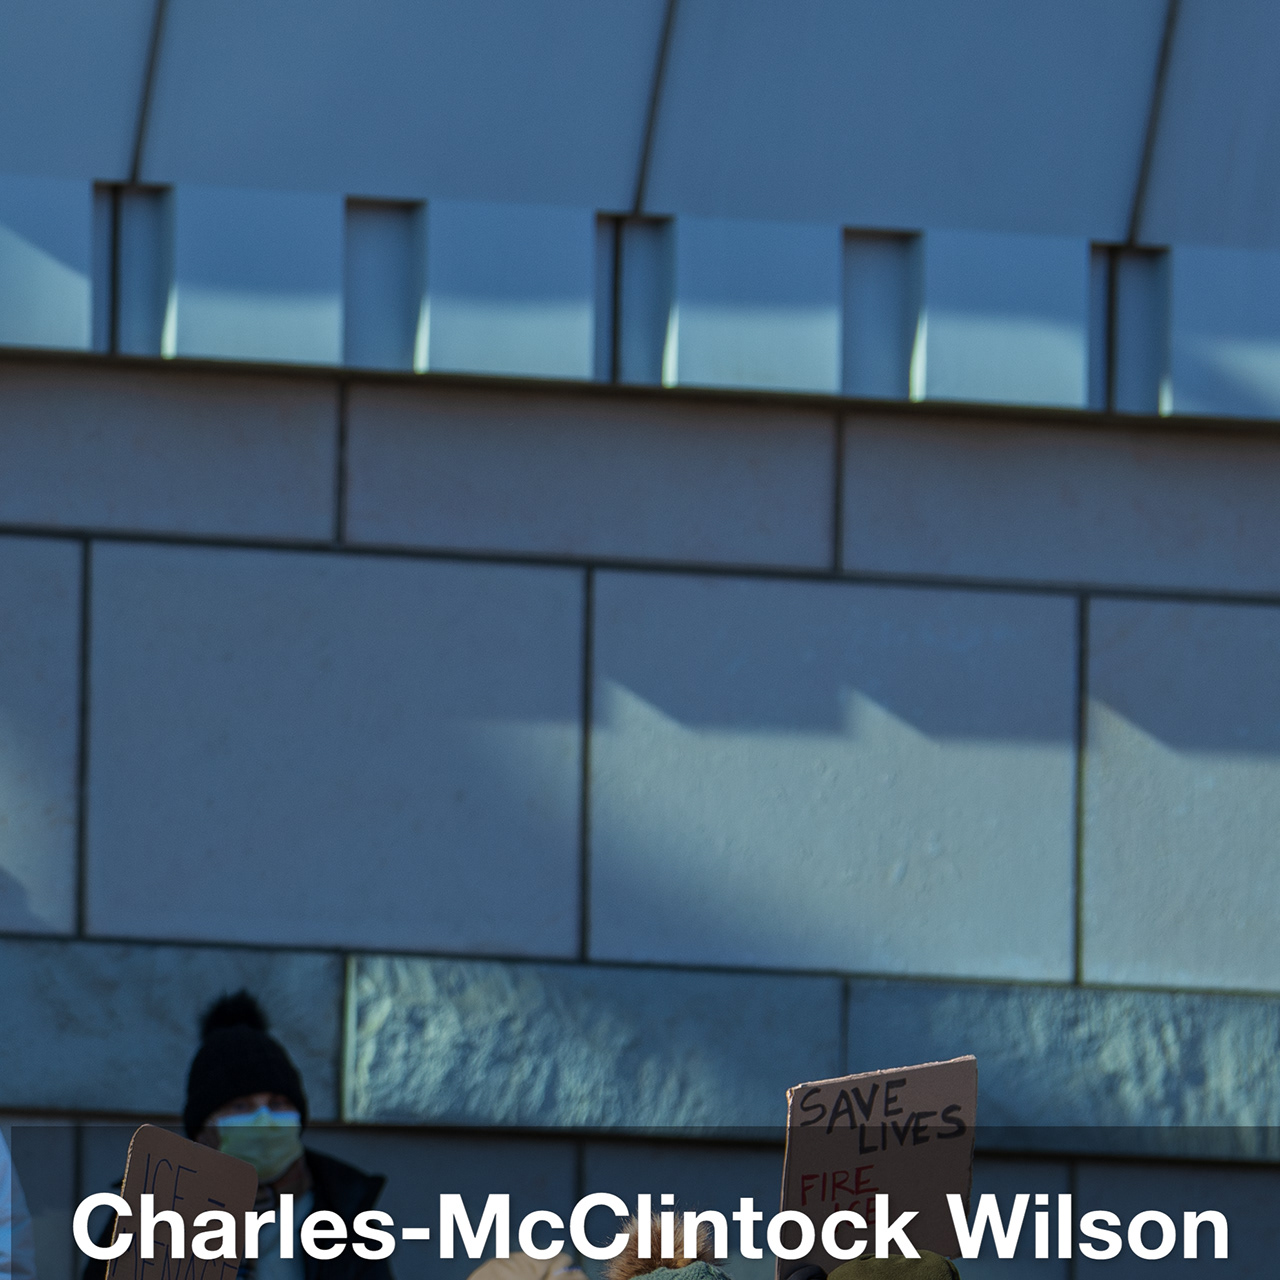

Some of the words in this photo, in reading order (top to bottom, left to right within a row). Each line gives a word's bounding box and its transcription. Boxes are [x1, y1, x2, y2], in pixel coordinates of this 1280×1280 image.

[800, 1078, 907, 1135] SAVE
[859, 1104, 967, 1155] LIVES
[801, 1165, 879, 1207] FIRE
